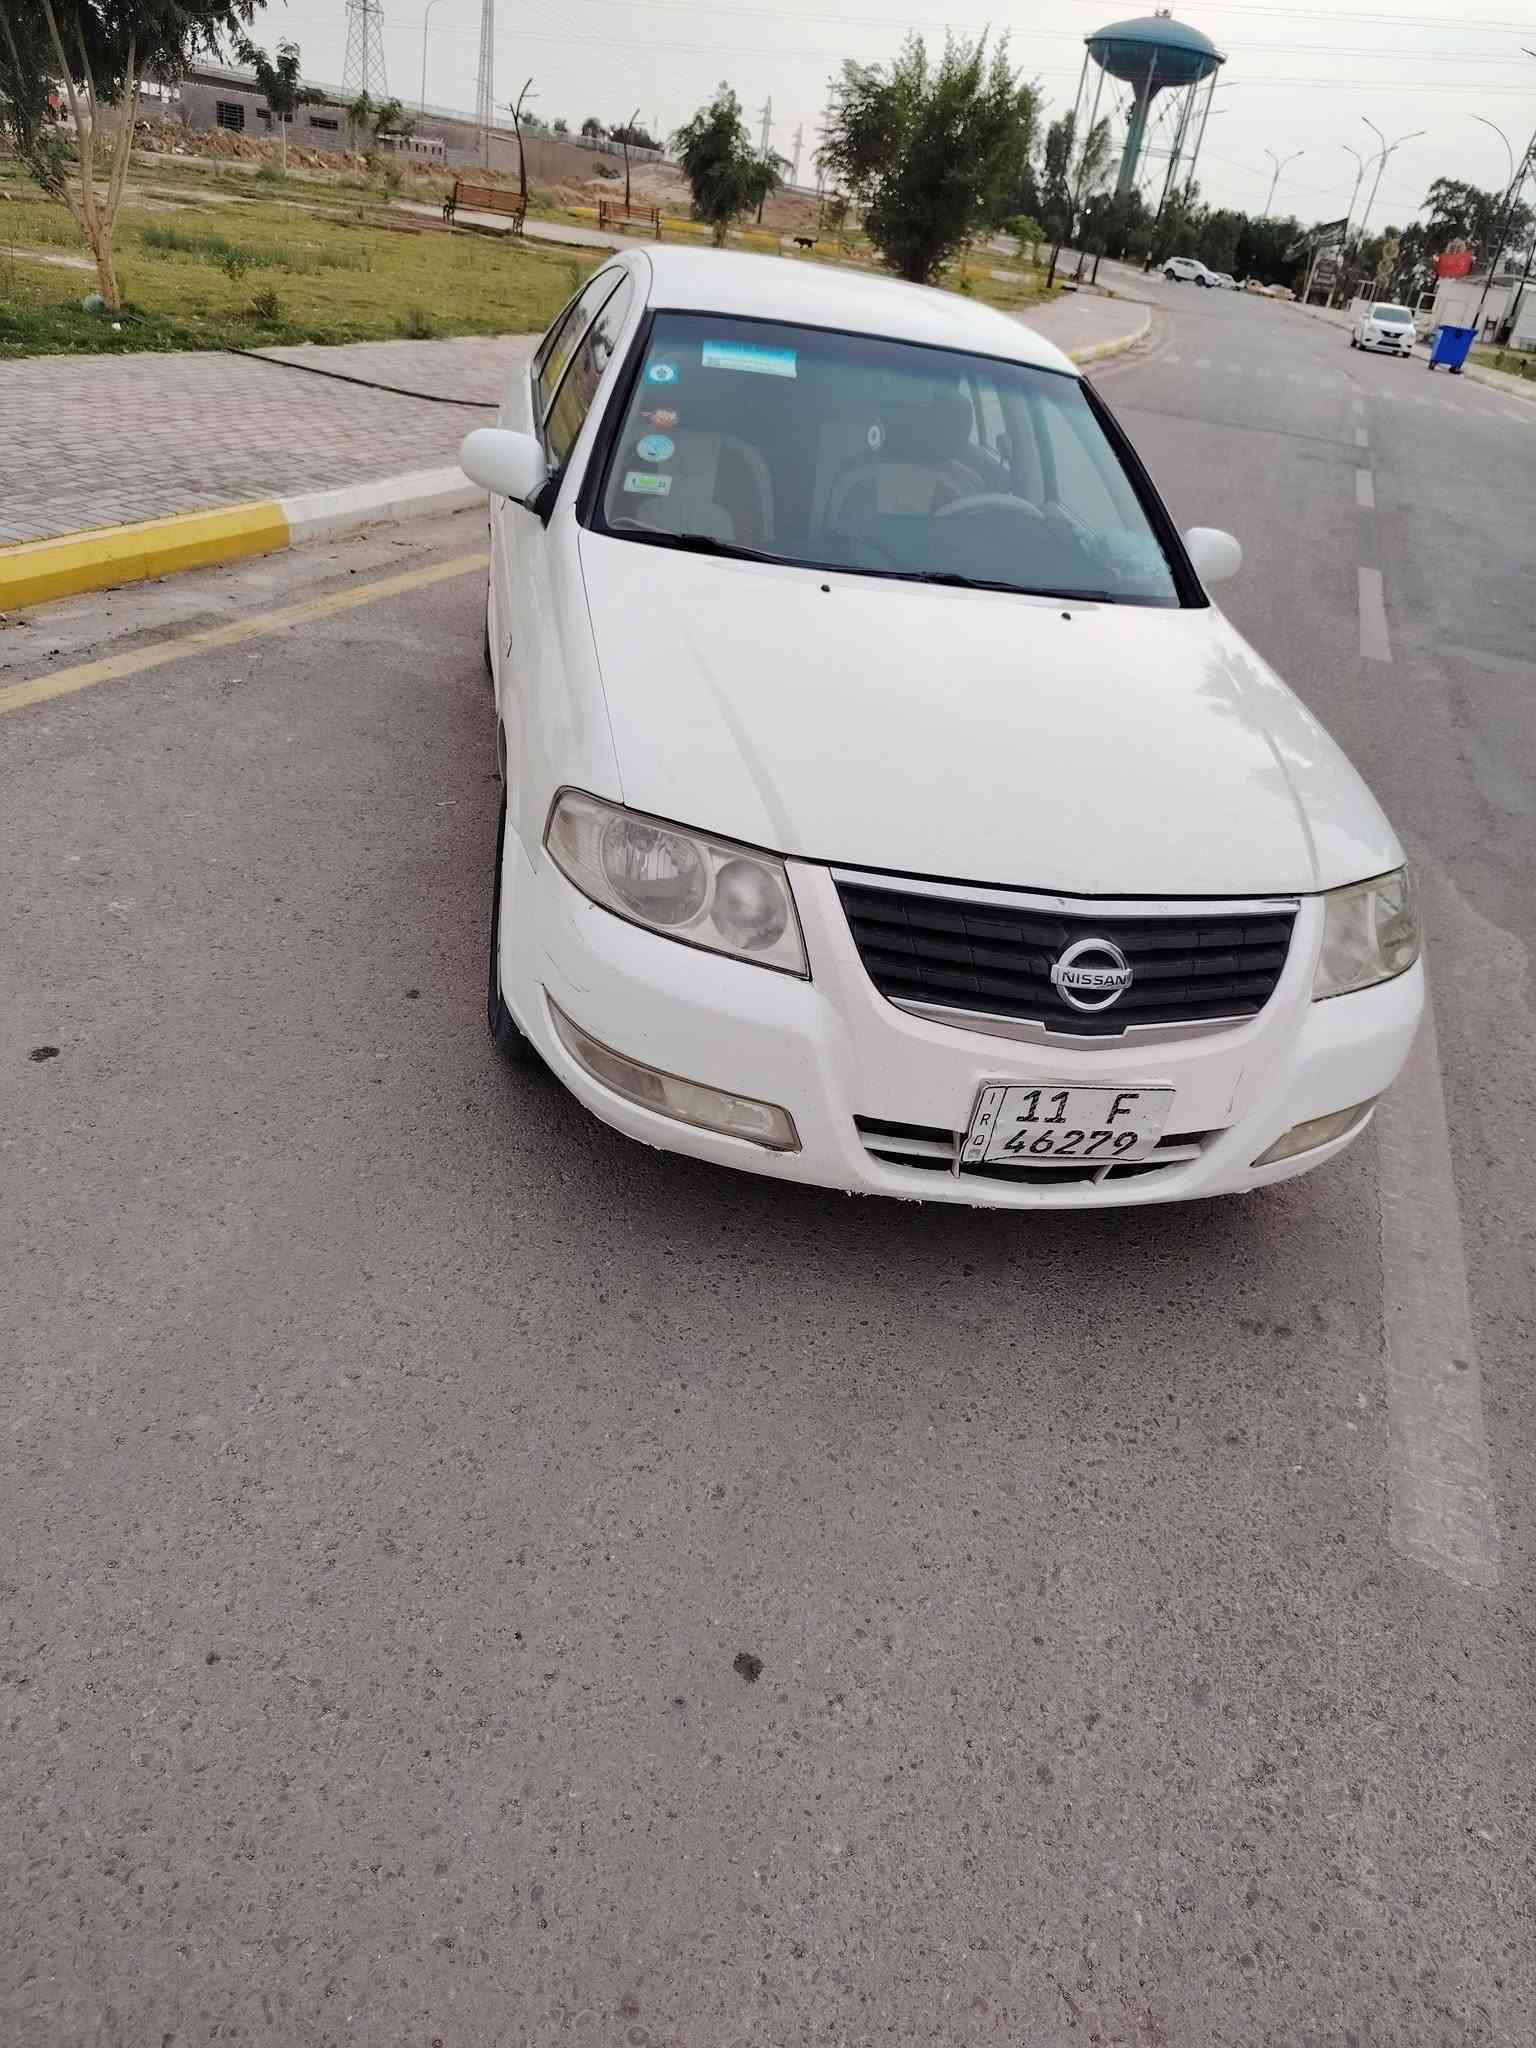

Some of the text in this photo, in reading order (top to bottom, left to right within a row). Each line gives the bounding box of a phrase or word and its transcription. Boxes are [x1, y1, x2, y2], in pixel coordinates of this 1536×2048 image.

[1061, 970, 1127, 986] NISSAN
[1016, 1090, 1140, 1124] 11 F
[1003, 1129, 1139, 1156] 46279
